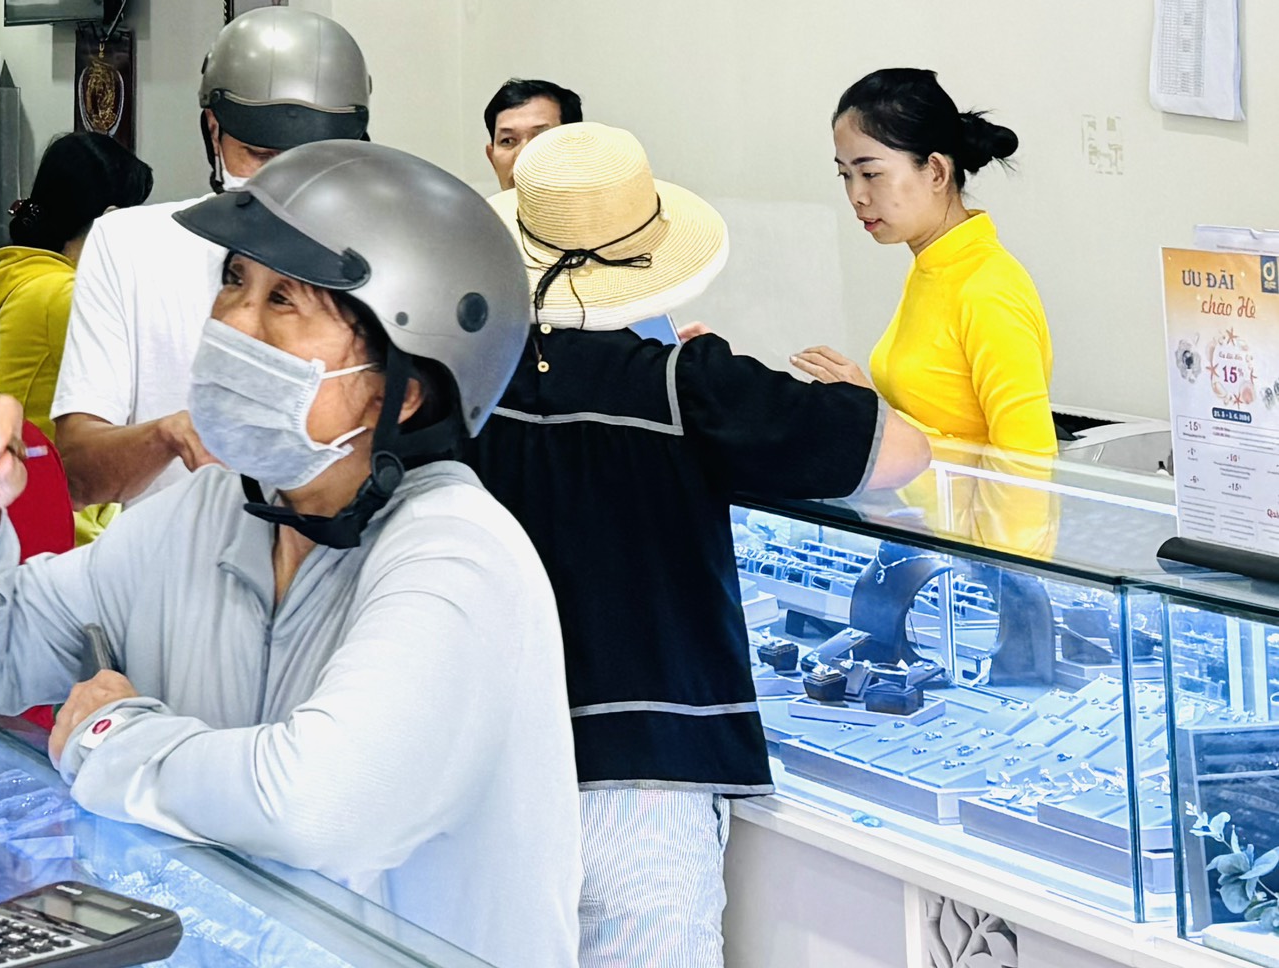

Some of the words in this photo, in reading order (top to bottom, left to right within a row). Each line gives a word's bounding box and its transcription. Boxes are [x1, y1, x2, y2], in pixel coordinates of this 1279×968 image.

[1182, 268, 1201, 288] ƯU
[1206, 266, 1234, 290] ĐÃI
[1200, 293, 1233, 317] chào
[1237, 296, 1257, 319] Hè
